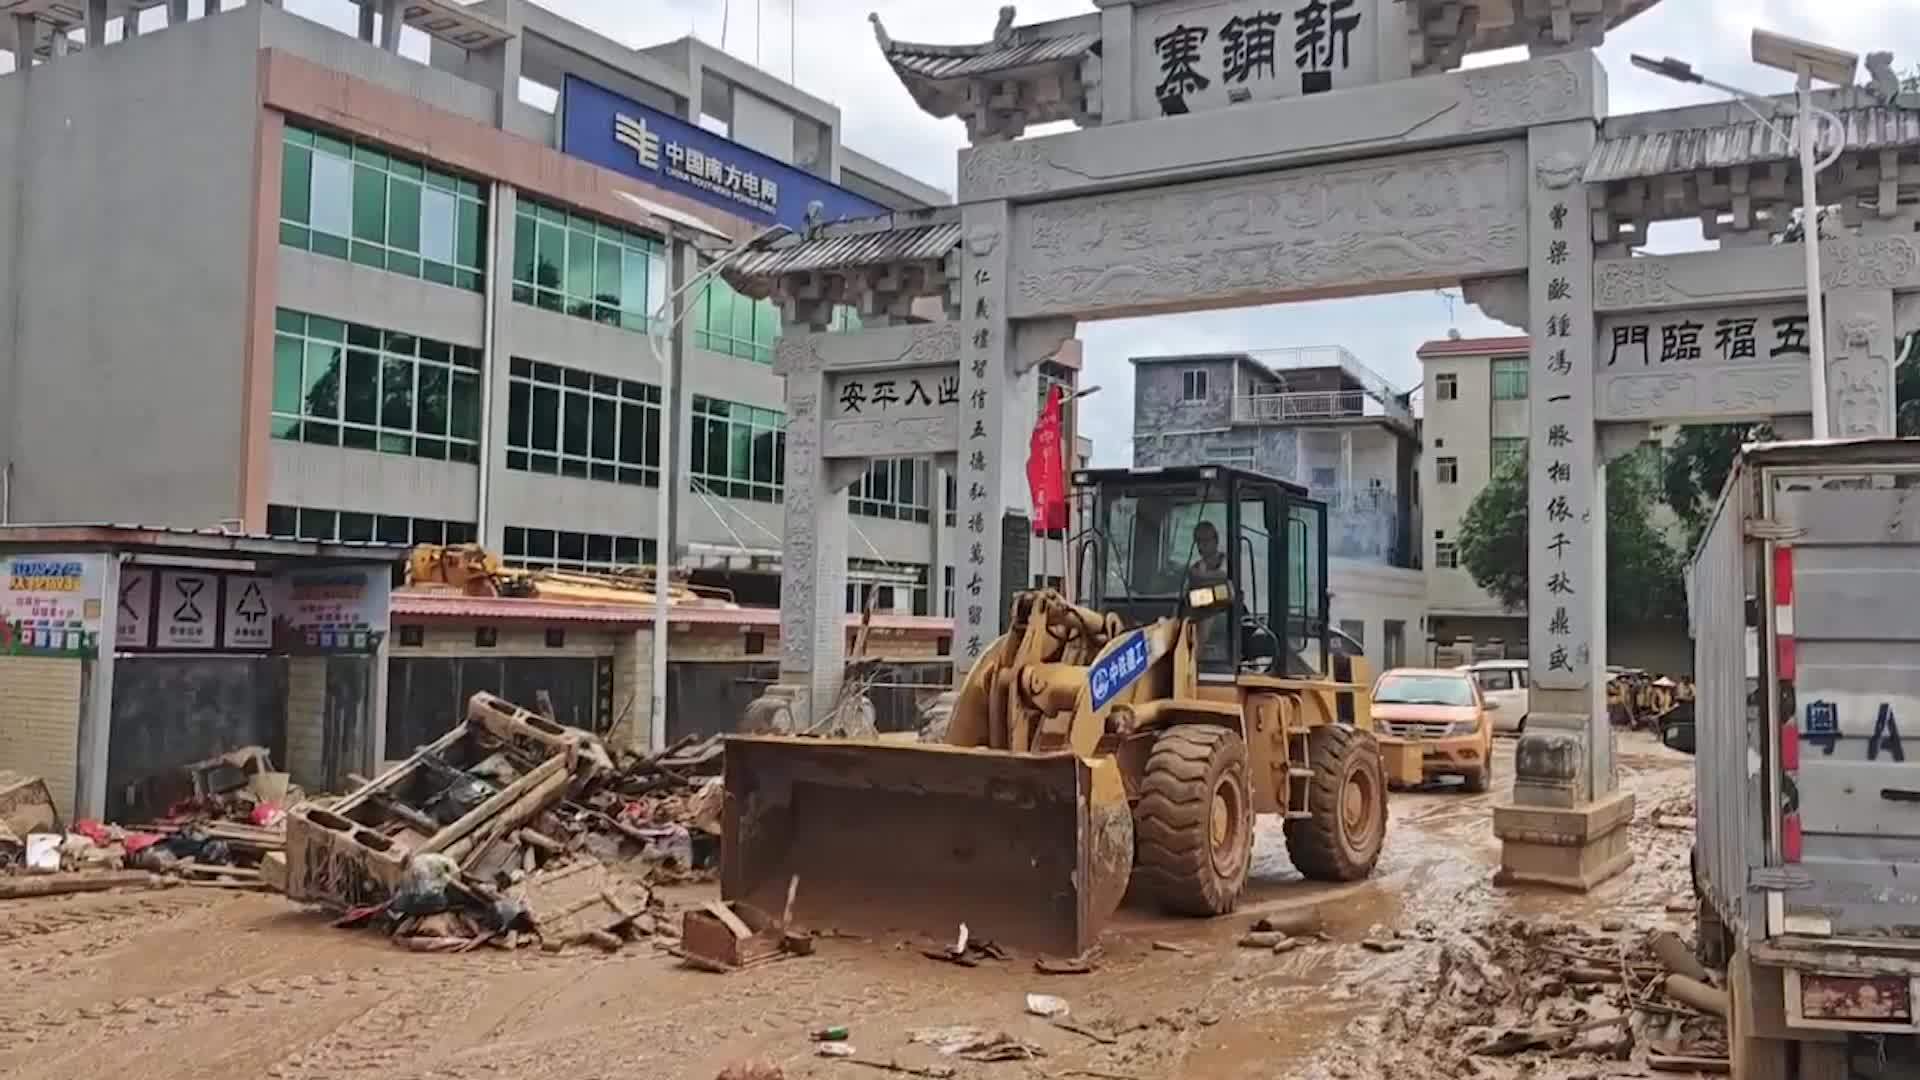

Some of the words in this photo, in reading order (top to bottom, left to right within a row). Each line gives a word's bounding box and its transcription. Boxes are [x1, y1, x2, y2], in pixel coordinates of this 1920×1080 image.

[665, 140, 777, 204] 中国南方电网
[1608, 315, 1811, 367] 五福臨門
[839, 375, 961, 413] 出入平安
